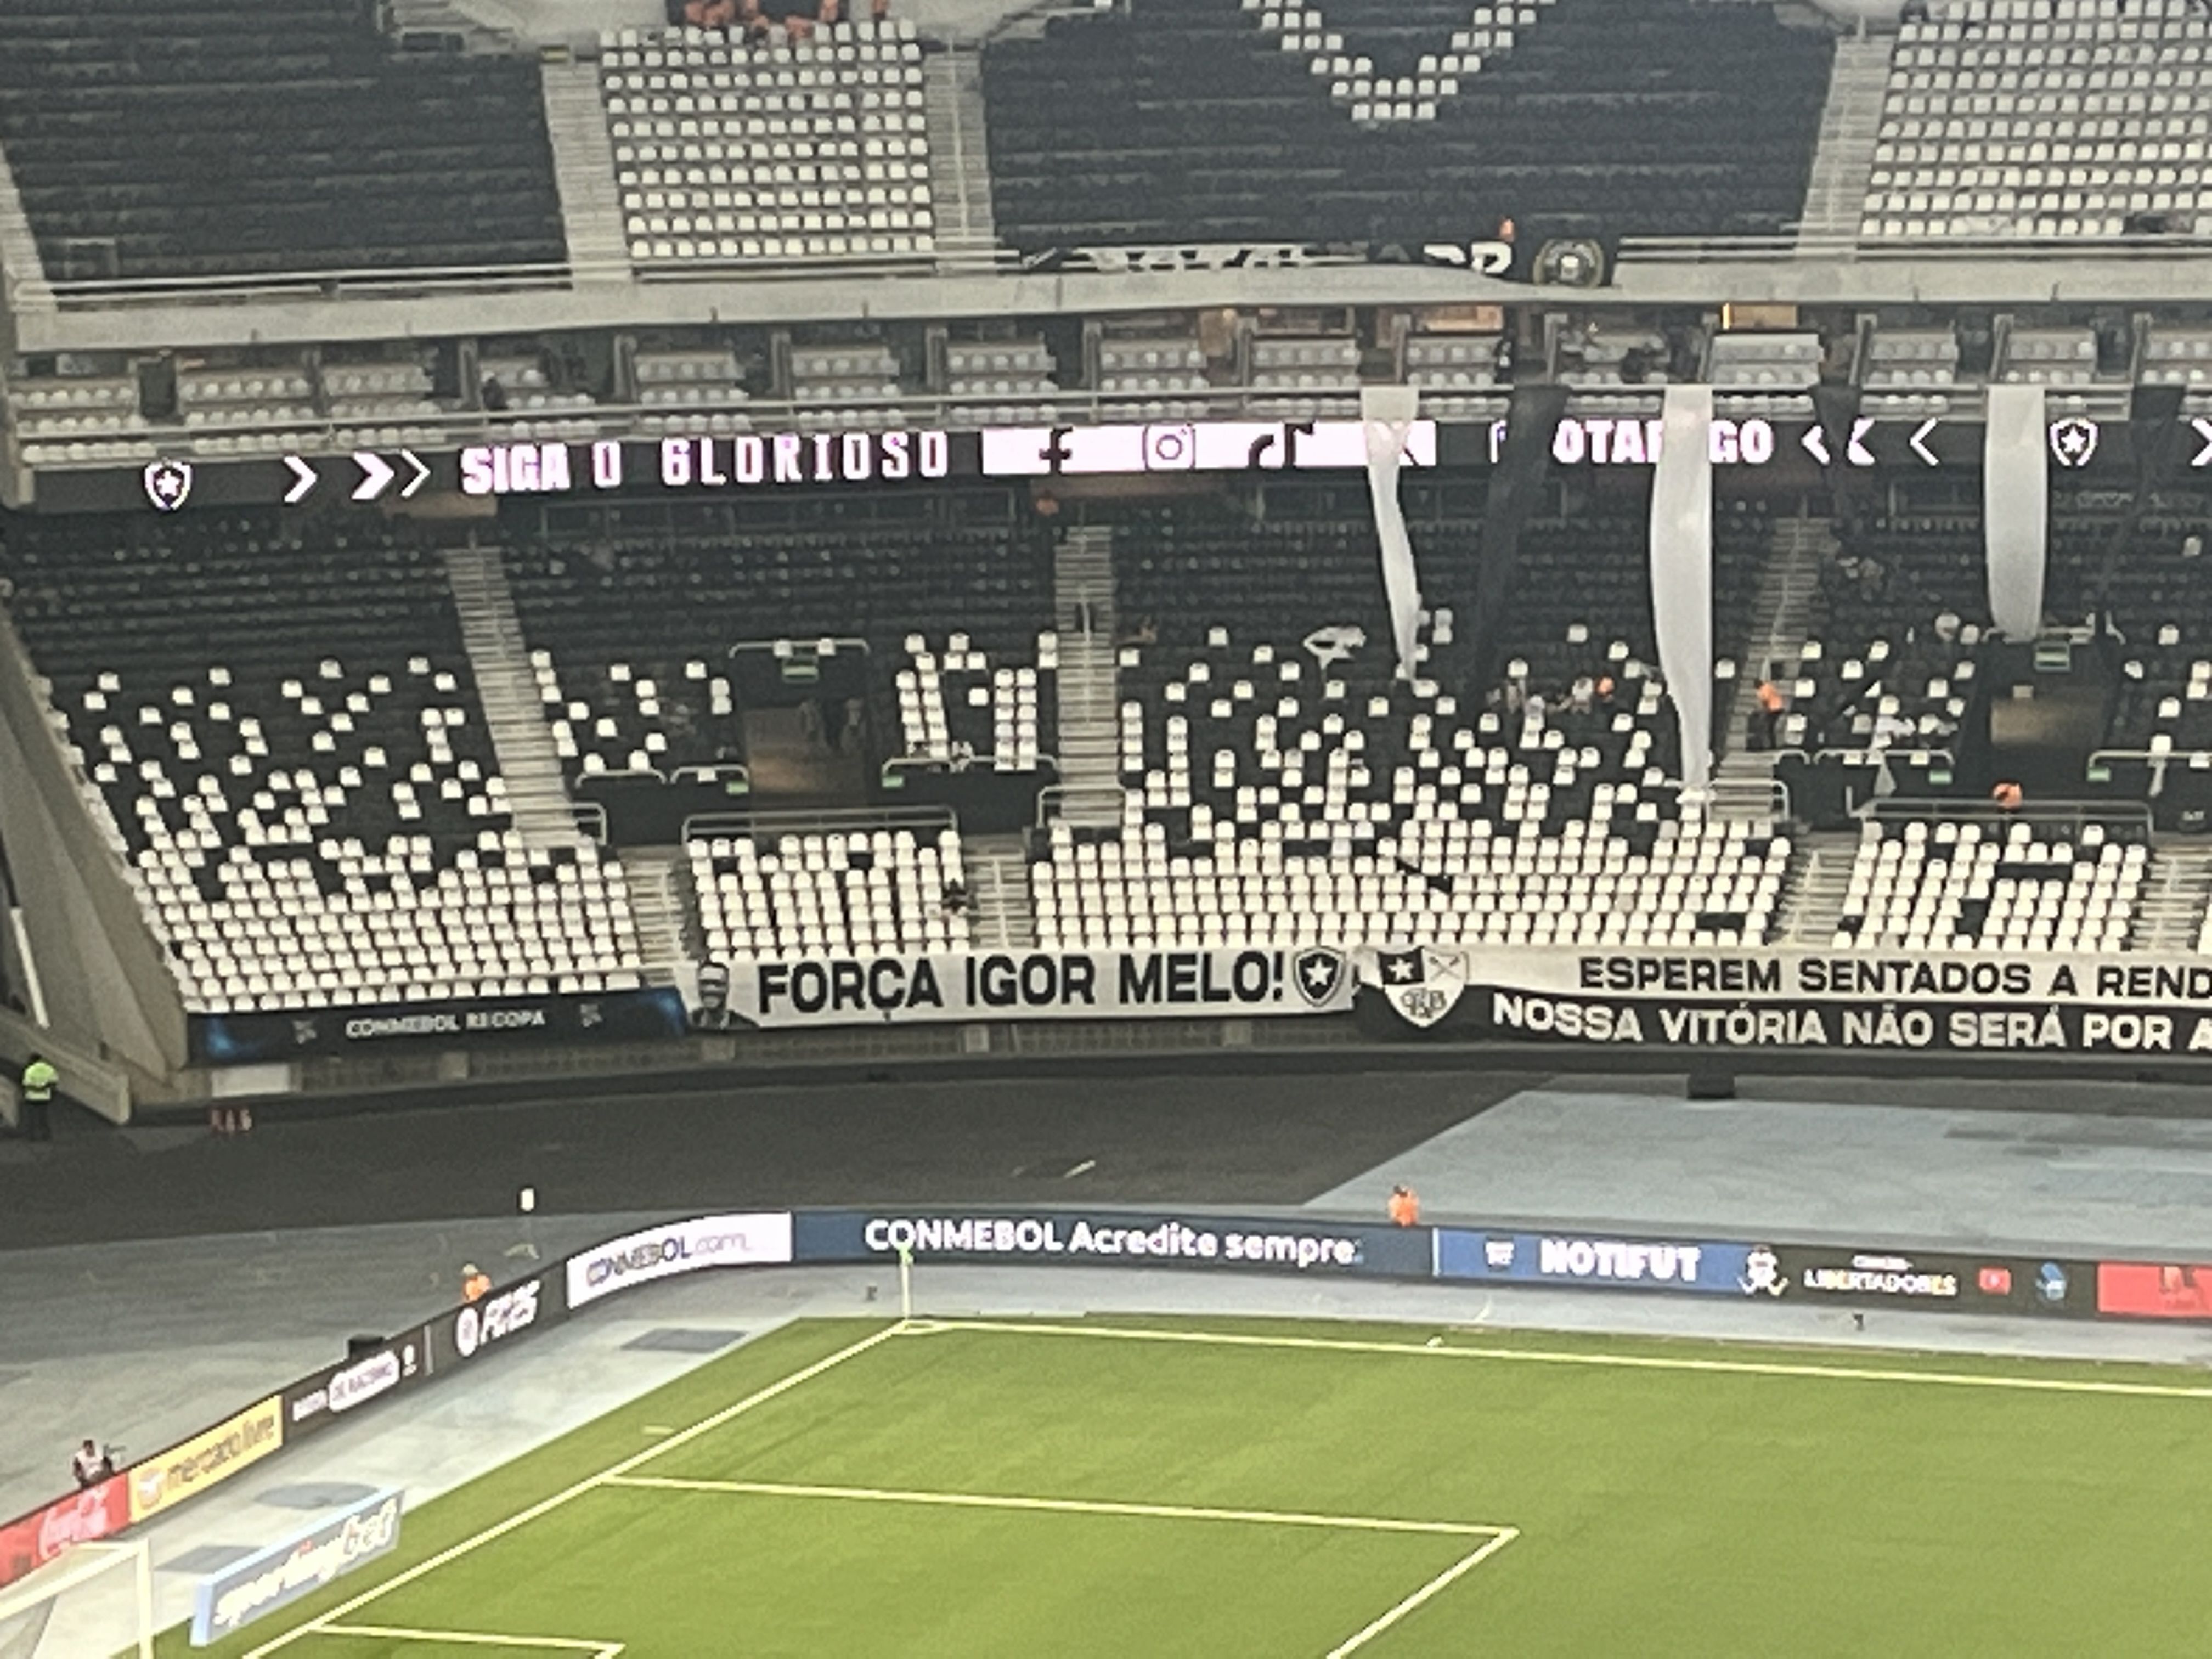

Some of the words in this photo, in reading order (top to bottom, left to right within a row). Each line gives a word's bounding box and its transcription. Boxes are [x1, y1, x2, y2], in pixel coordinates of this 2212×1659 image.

[460, 442, 571, 494] SIGA
[592, 440, 622, 488] O
[662, 431, 948, 485] GLORIOSO
[965, 954, 1096, 1007] IGOR
[1119, 950, 1284, 1005] MELO!
[1579, 956, 1781, 993] ESPEREM
[1798, 958, 2032, 995] SENTADOS
[2047, 964, 2079, 996] A
[1493, 991, 1644, 1042] NOSSA
[1658, 1001, 1827, 1045] VITÓRIA
[1842, 1002, 1934, 1047] NÃO
[1948, 1003, 2067, 1048] SERÁ
[2083, 1013, 2173, 1050] POR
[865, 1218, 1064, 1251] CONMEBOL
[1068, 1221, 1218, 1257] Acredite
[1540, 1238, 1701, 1282] NOTIFUT
